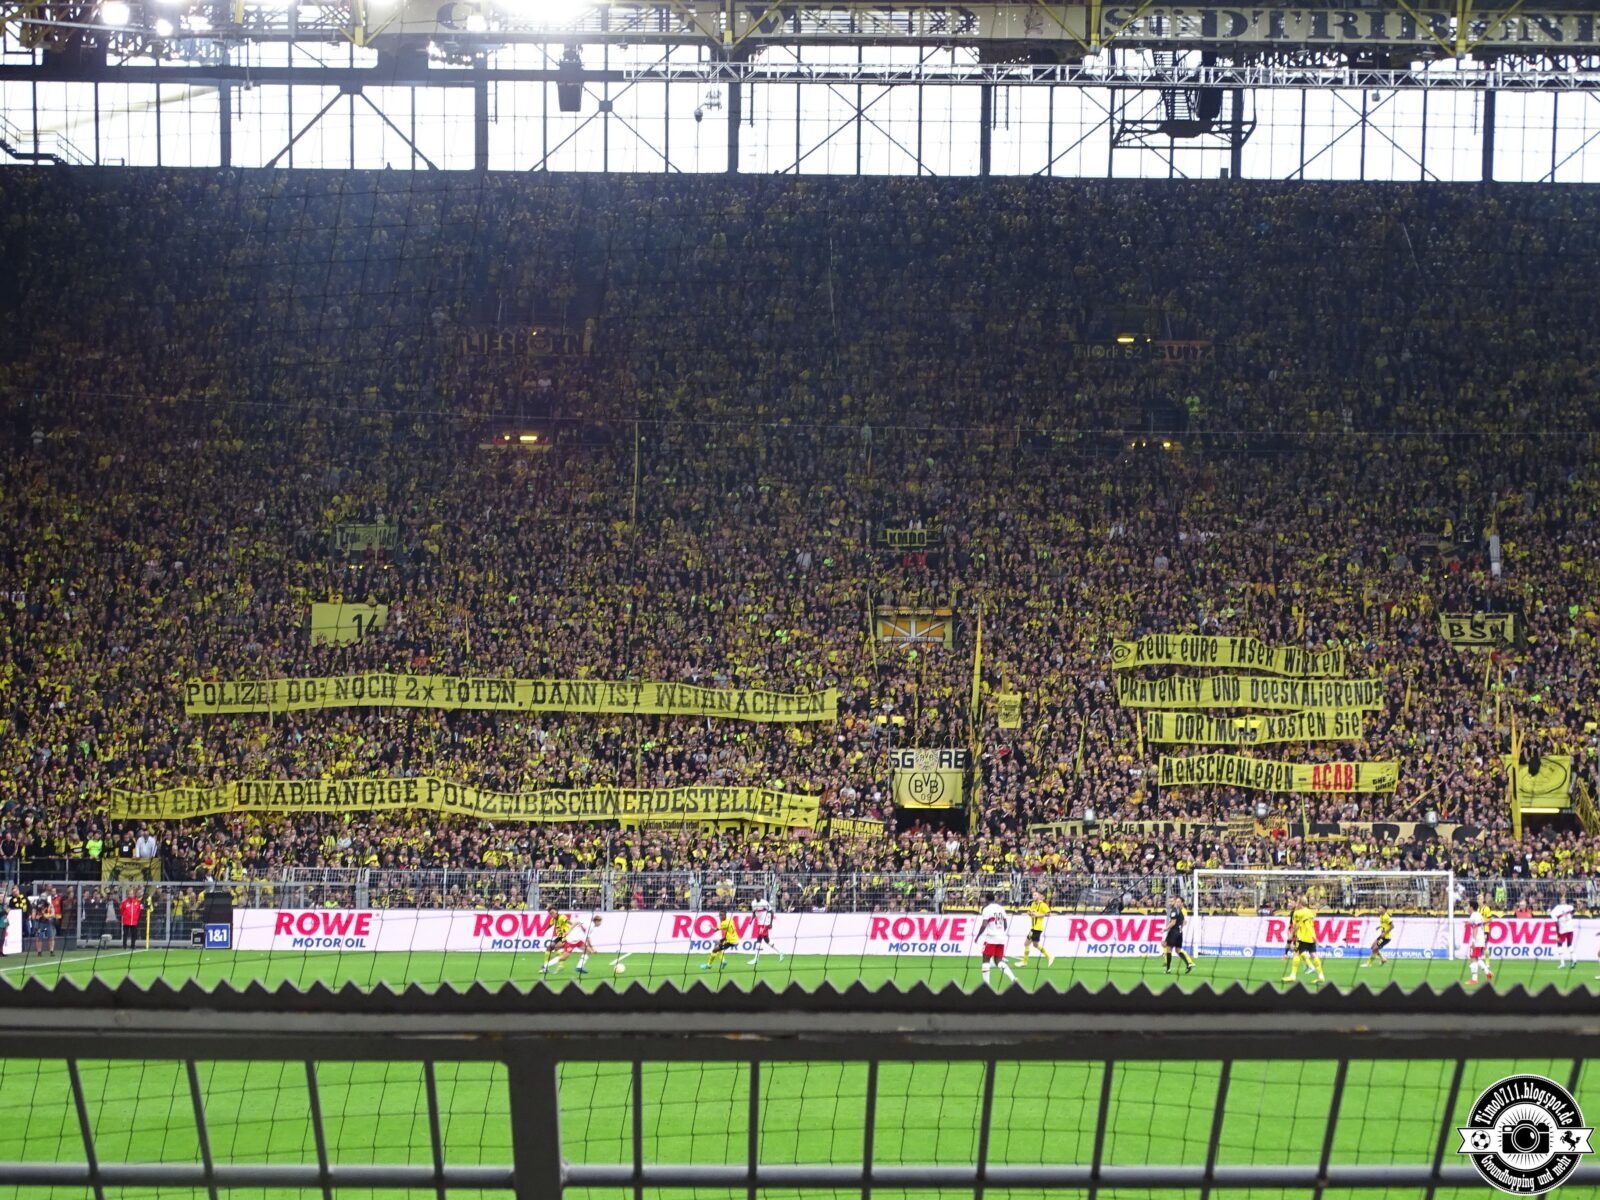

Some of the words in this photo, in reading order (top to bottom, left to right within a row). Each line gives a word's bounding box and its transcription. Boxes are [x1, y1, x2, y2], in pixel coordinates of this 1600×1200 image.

[186, 680, 278, 706] POLIZEI
[286, 679, 326, 704] DO:
[334, 675, 396, 700] NOCH
[532, 681, 598, 706] DANN
[606, 682, 644, 707] IST
[655, 683, 826, 714] WEIHNACHTEN
[1212, 676, 1241, 701] UND
[111, 789, 161, 815] FÜR
[171, 785, 228, 814] EINE
[236, 779, 418, 805] UNABHÄNGIGE
[426, 779, 782, 817] POLIZEIBESCHWERDESTELLE!
[207, 929, 227, 941] 1&1
[274, 912, 373, 936] ROWE
[473, 913, 572, 937] ROW
[870, 917, 969, 940] ROWE
[1068, 918, 1166, 942] ROWE
[1266, 919, 1363, 943] RWE
[292, 937, 342, 948] MOTOR
[345, 937, 366, 948] OIL
[492, 939, 540, 949] MOTOR
[690, 940, 738, 950] MOR
[888, 942, 938, 952] MOTOR
[940, 943, 962, 953] OIL
[1087, 943, 1136, 954] MOTOR
[1139, 944, 1160, 954] OIL
[1533, 947, 1554, 957] OIL
